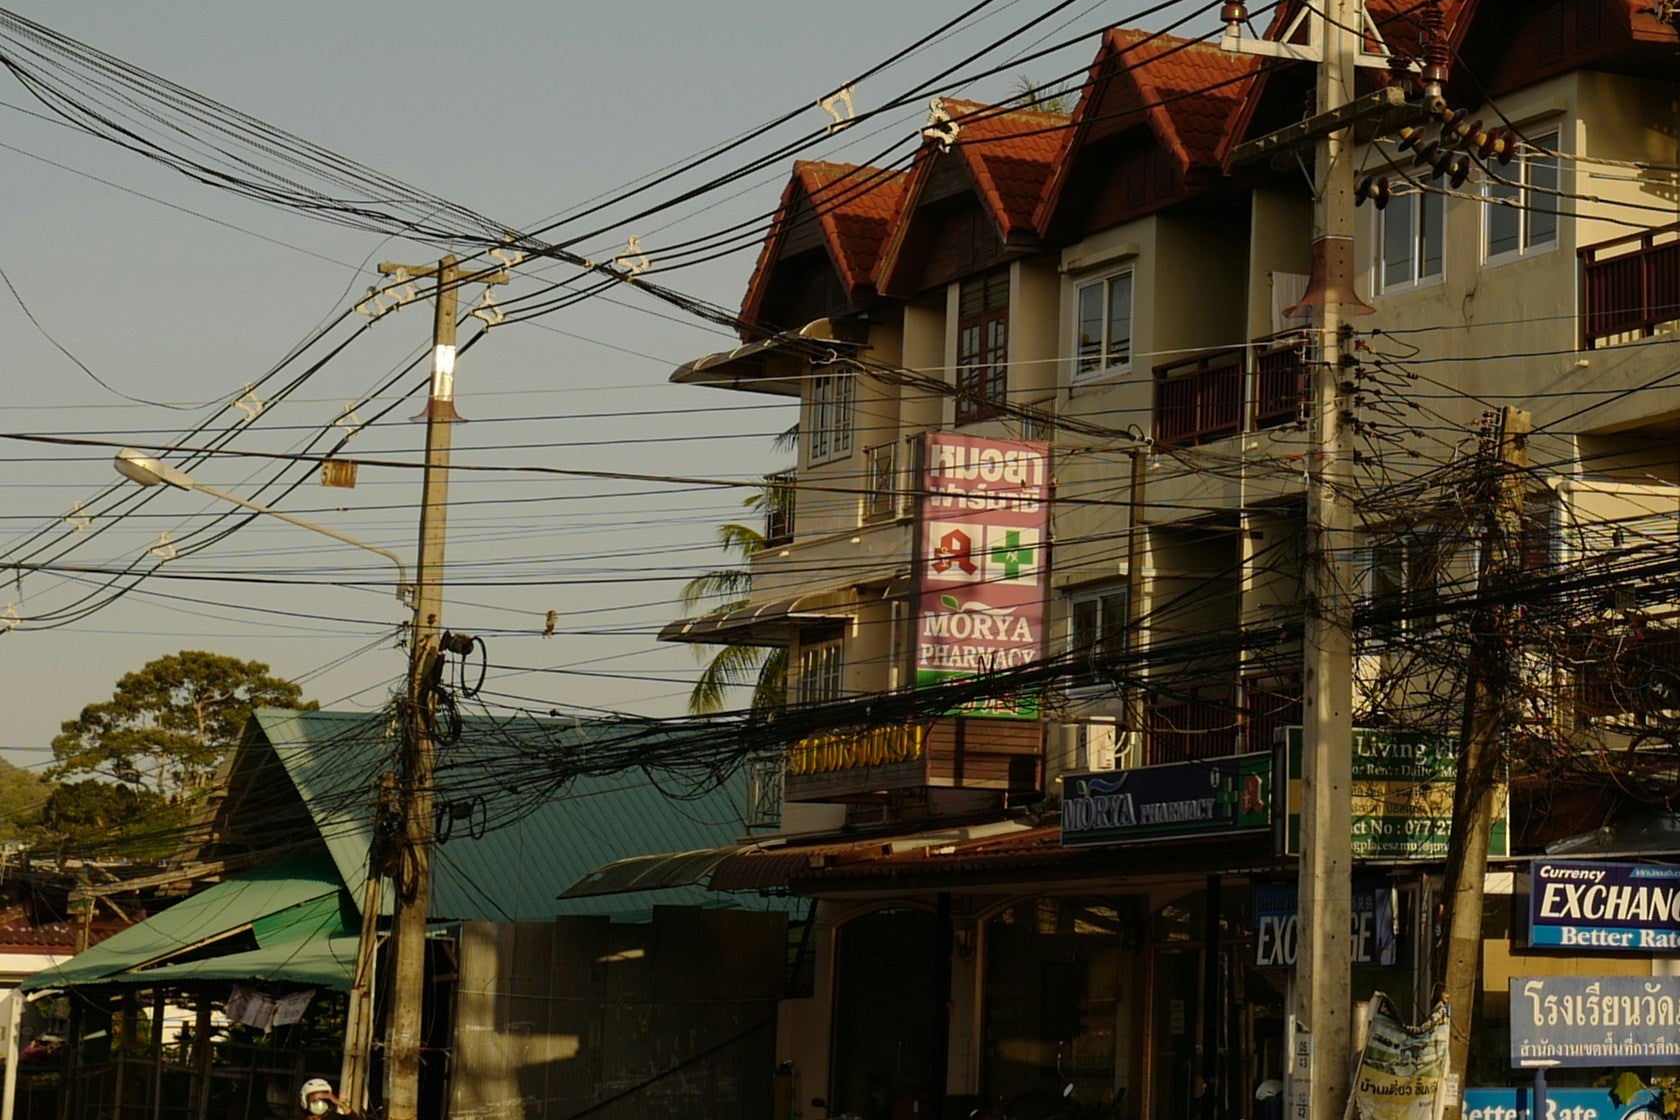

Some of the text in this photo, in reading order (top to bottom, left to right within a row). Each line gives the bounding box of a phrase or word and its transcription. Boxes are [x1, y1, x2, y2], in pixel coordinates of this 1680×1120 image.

[930, 444, 1043, 486] หมอยา
[923, 611, 1033, 642] MORYA
[920, 643, 1036, 672] PHARMACY
[1355, 736, 1429, 765] Living
[1063, 792, 1216, 832] MORYA PHARMACY
[1370, 820, 1393, 836] No
[1540, 865, 1606, 883] Currency
[1256, 911, 1373, 966] EXCGE
[1560, 926, 1634, 947] Better
